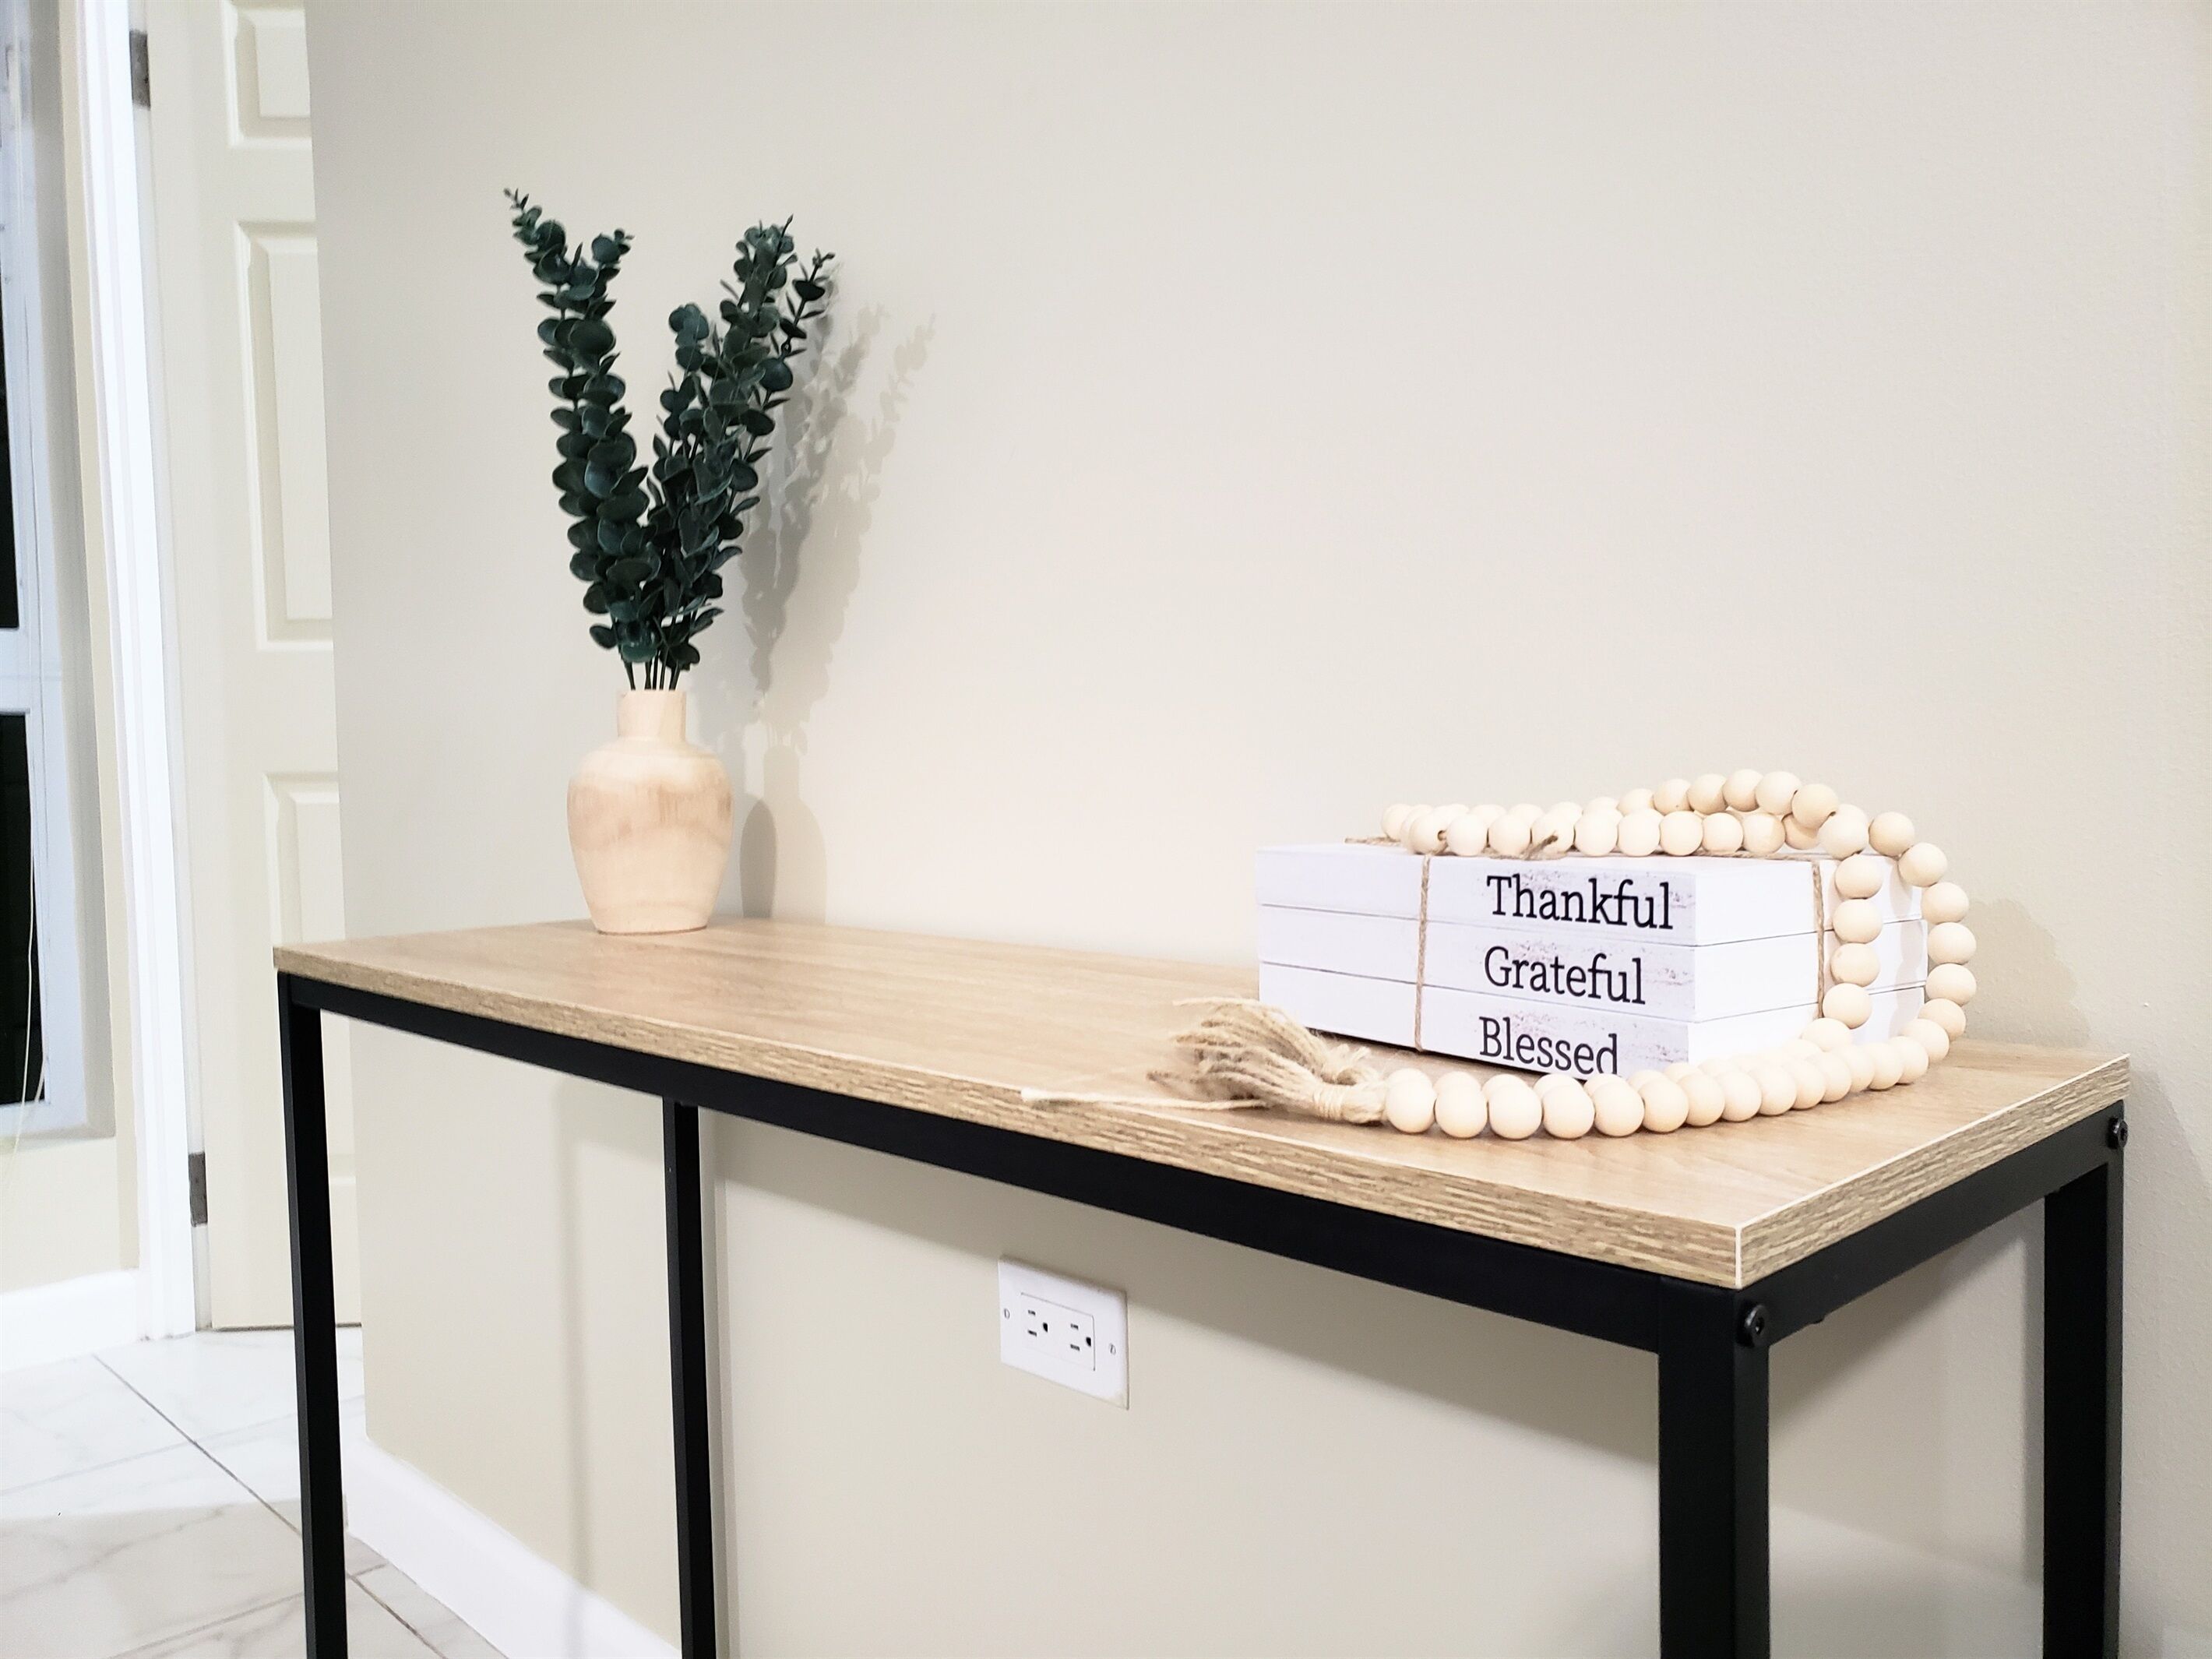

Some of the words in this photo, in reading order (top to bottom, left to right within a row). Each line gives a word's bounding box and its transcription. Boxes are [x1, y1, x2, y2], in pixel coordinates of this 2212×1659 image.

[1486, 873, 1674, 930] Thankful
[1484, 946, 1646, 1005] Grateful
[1478, 1016, 1618, 1075] Blessed
